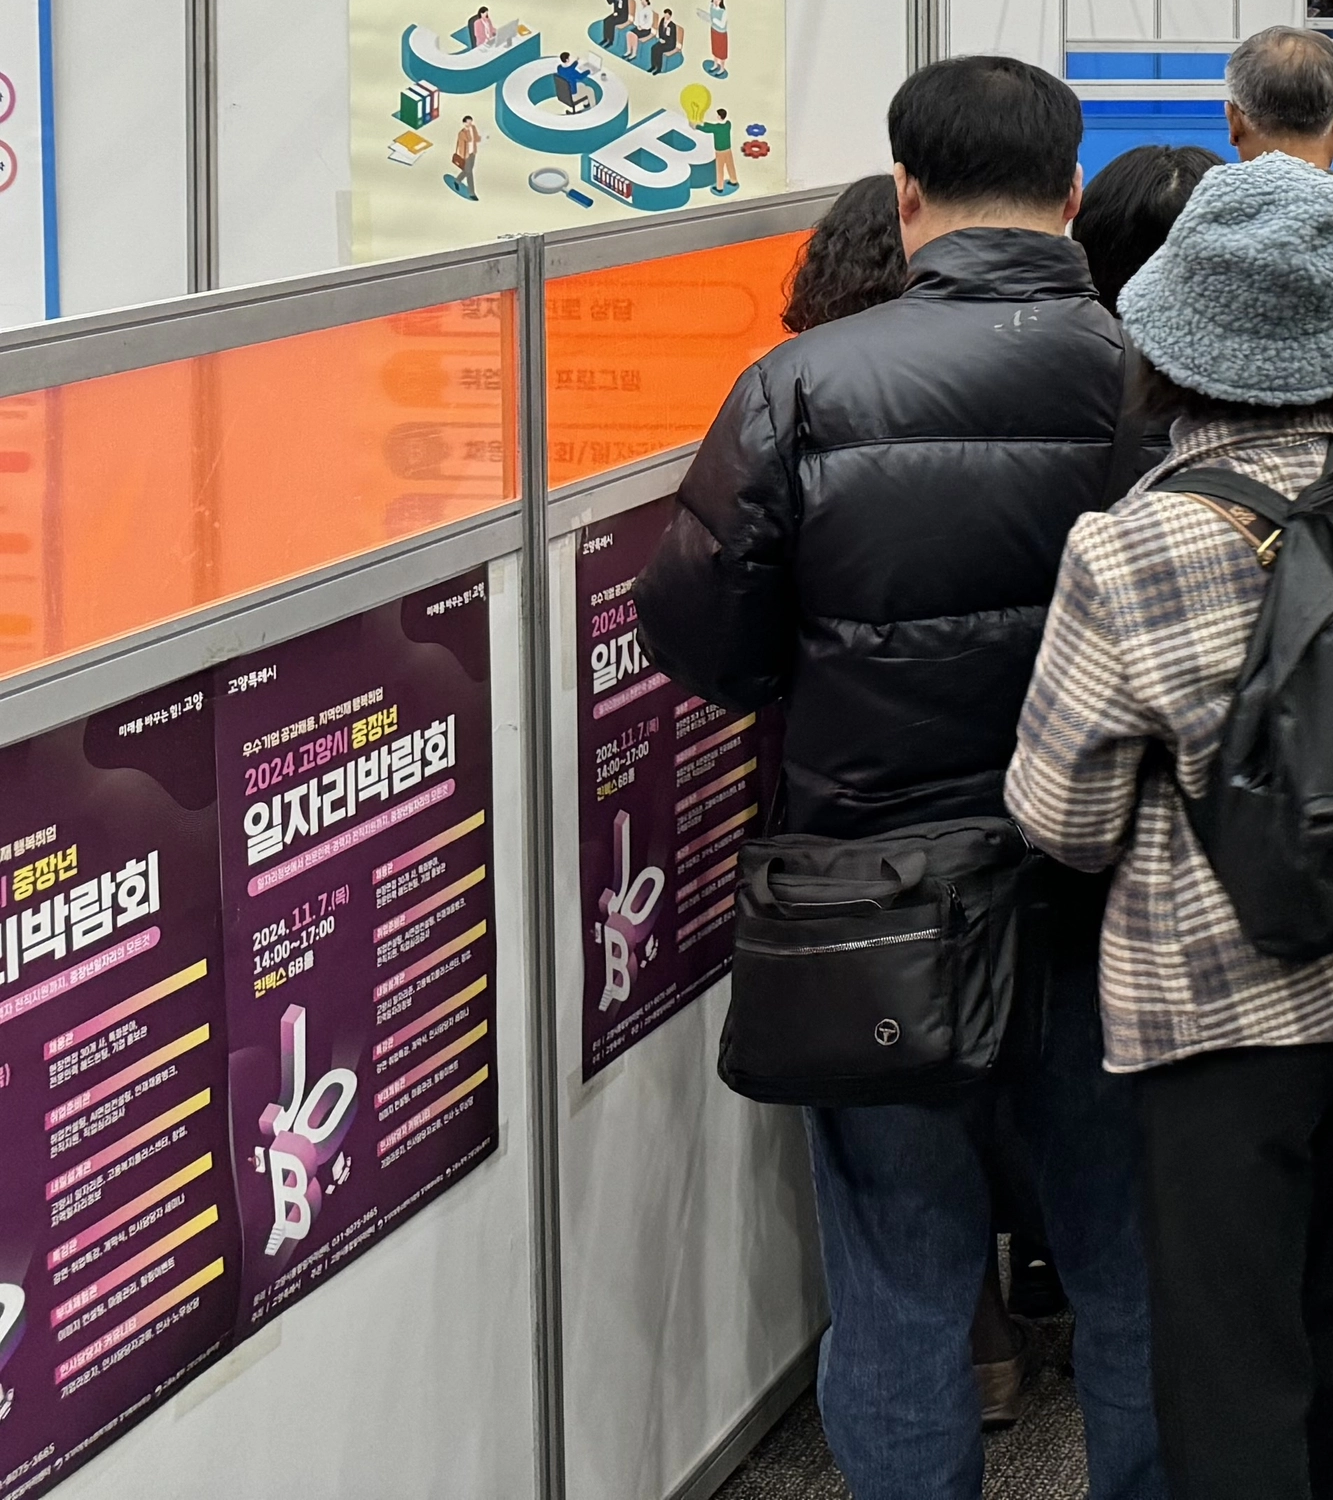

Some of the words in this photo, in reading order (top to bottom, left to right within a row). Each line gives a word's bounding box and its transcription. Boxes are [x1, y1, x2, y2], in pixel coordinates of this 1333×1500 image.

[591, 604, 625, 638] 2024
[182, 690, 204, 713] 고양
[228, 665, 277, 694] 고양특례시
[242, 731, 280, 757] 우수기업
[281, 716, 318, 742] 공감채용,
[319, 701, 351, 726] 지역인재
[245, 754, 295, 796] 2024
[298, 726, 349, 774] 고양시
[351, 704, 399, 749] 중장년
[596, 741, 620, 764] 2024.
[596, 740, 649, 784] 14:00~17:00
[243, 714, 456, 866] 일자리박람회
[13, 824, 57, 854] 행복취업
[12, 844, 78, 901] 중장년
[253, 919, 289, 952] 2024.
[292, 902, 316, 931] 11.
[318, 884, 350, 916] 7.(목)
[254, 915, 335, 975] 14:00~17:00
[254, 967, 287, 999] 킨텍스
